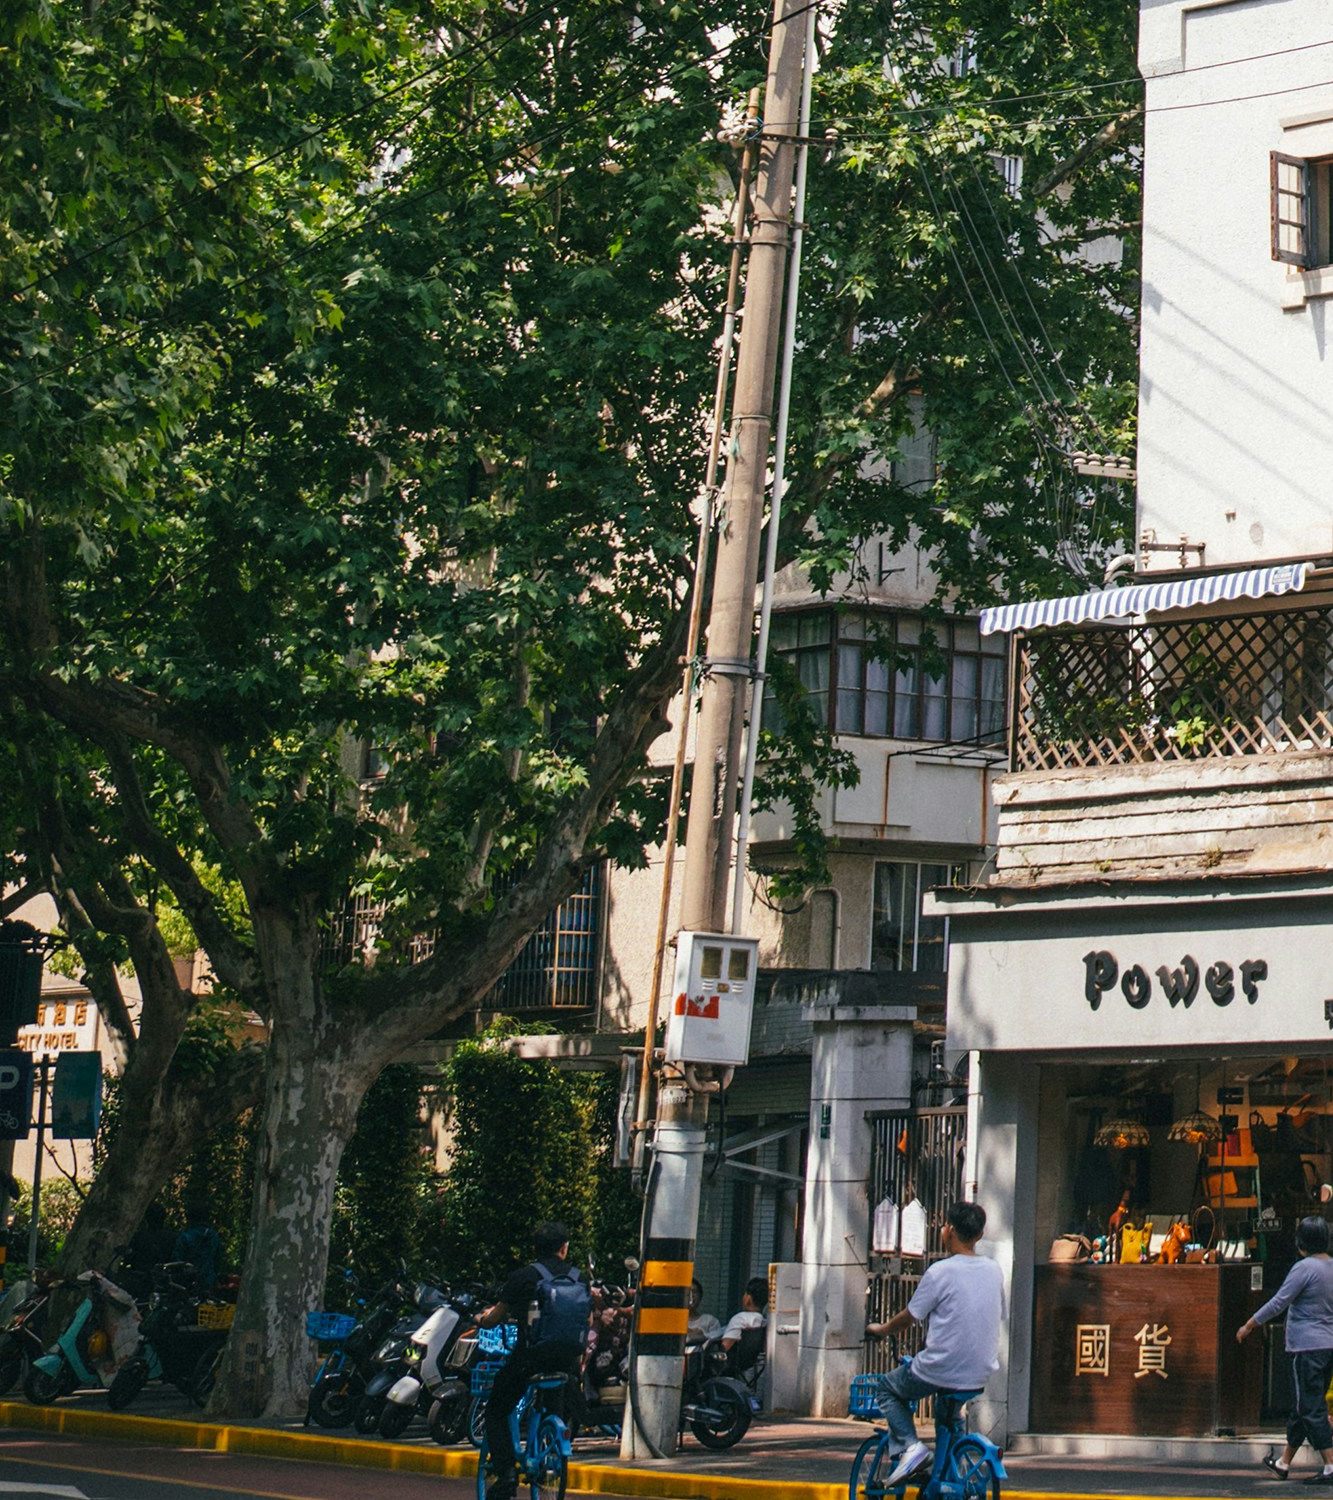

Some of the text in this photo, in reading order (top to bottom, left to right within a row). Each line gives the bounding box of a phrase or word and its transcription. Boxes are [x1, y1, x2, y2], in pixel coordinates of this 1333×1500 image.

[1082, 950, 1268, 1011] Power
[44, 1032, 79, 1050] HOTEL
[1075, 1323, 1172, 1379] 國貨
